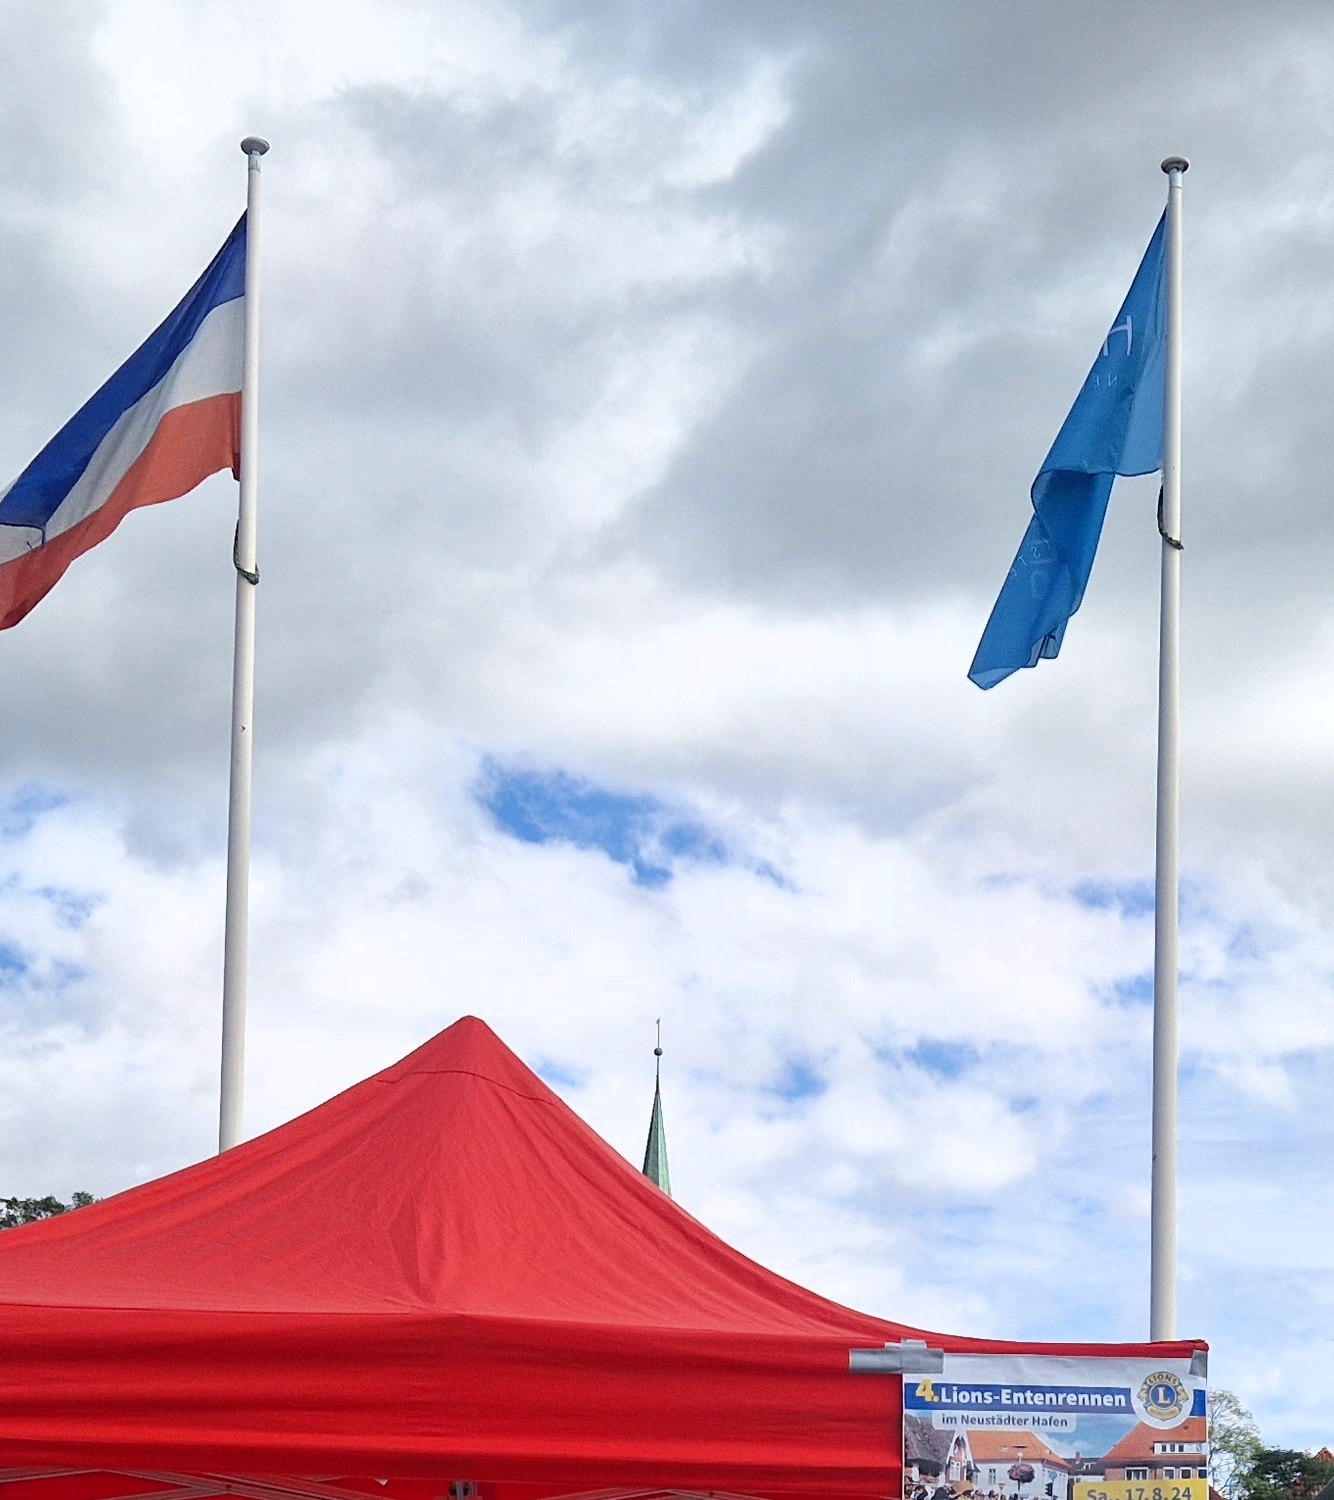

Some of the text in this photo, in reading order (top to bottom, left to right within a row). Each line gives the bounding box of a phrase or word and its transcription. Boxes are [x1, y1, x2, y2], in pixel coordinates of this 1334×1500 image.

[1147, 1373, 1178, 1385] LIONS
[941, 1387, 1126, 1407] Lions-Entenrennen
[1156, 1386, 1171, 1404] L
[941, 1413, 1068, 1428] im Neustädter Hafen
